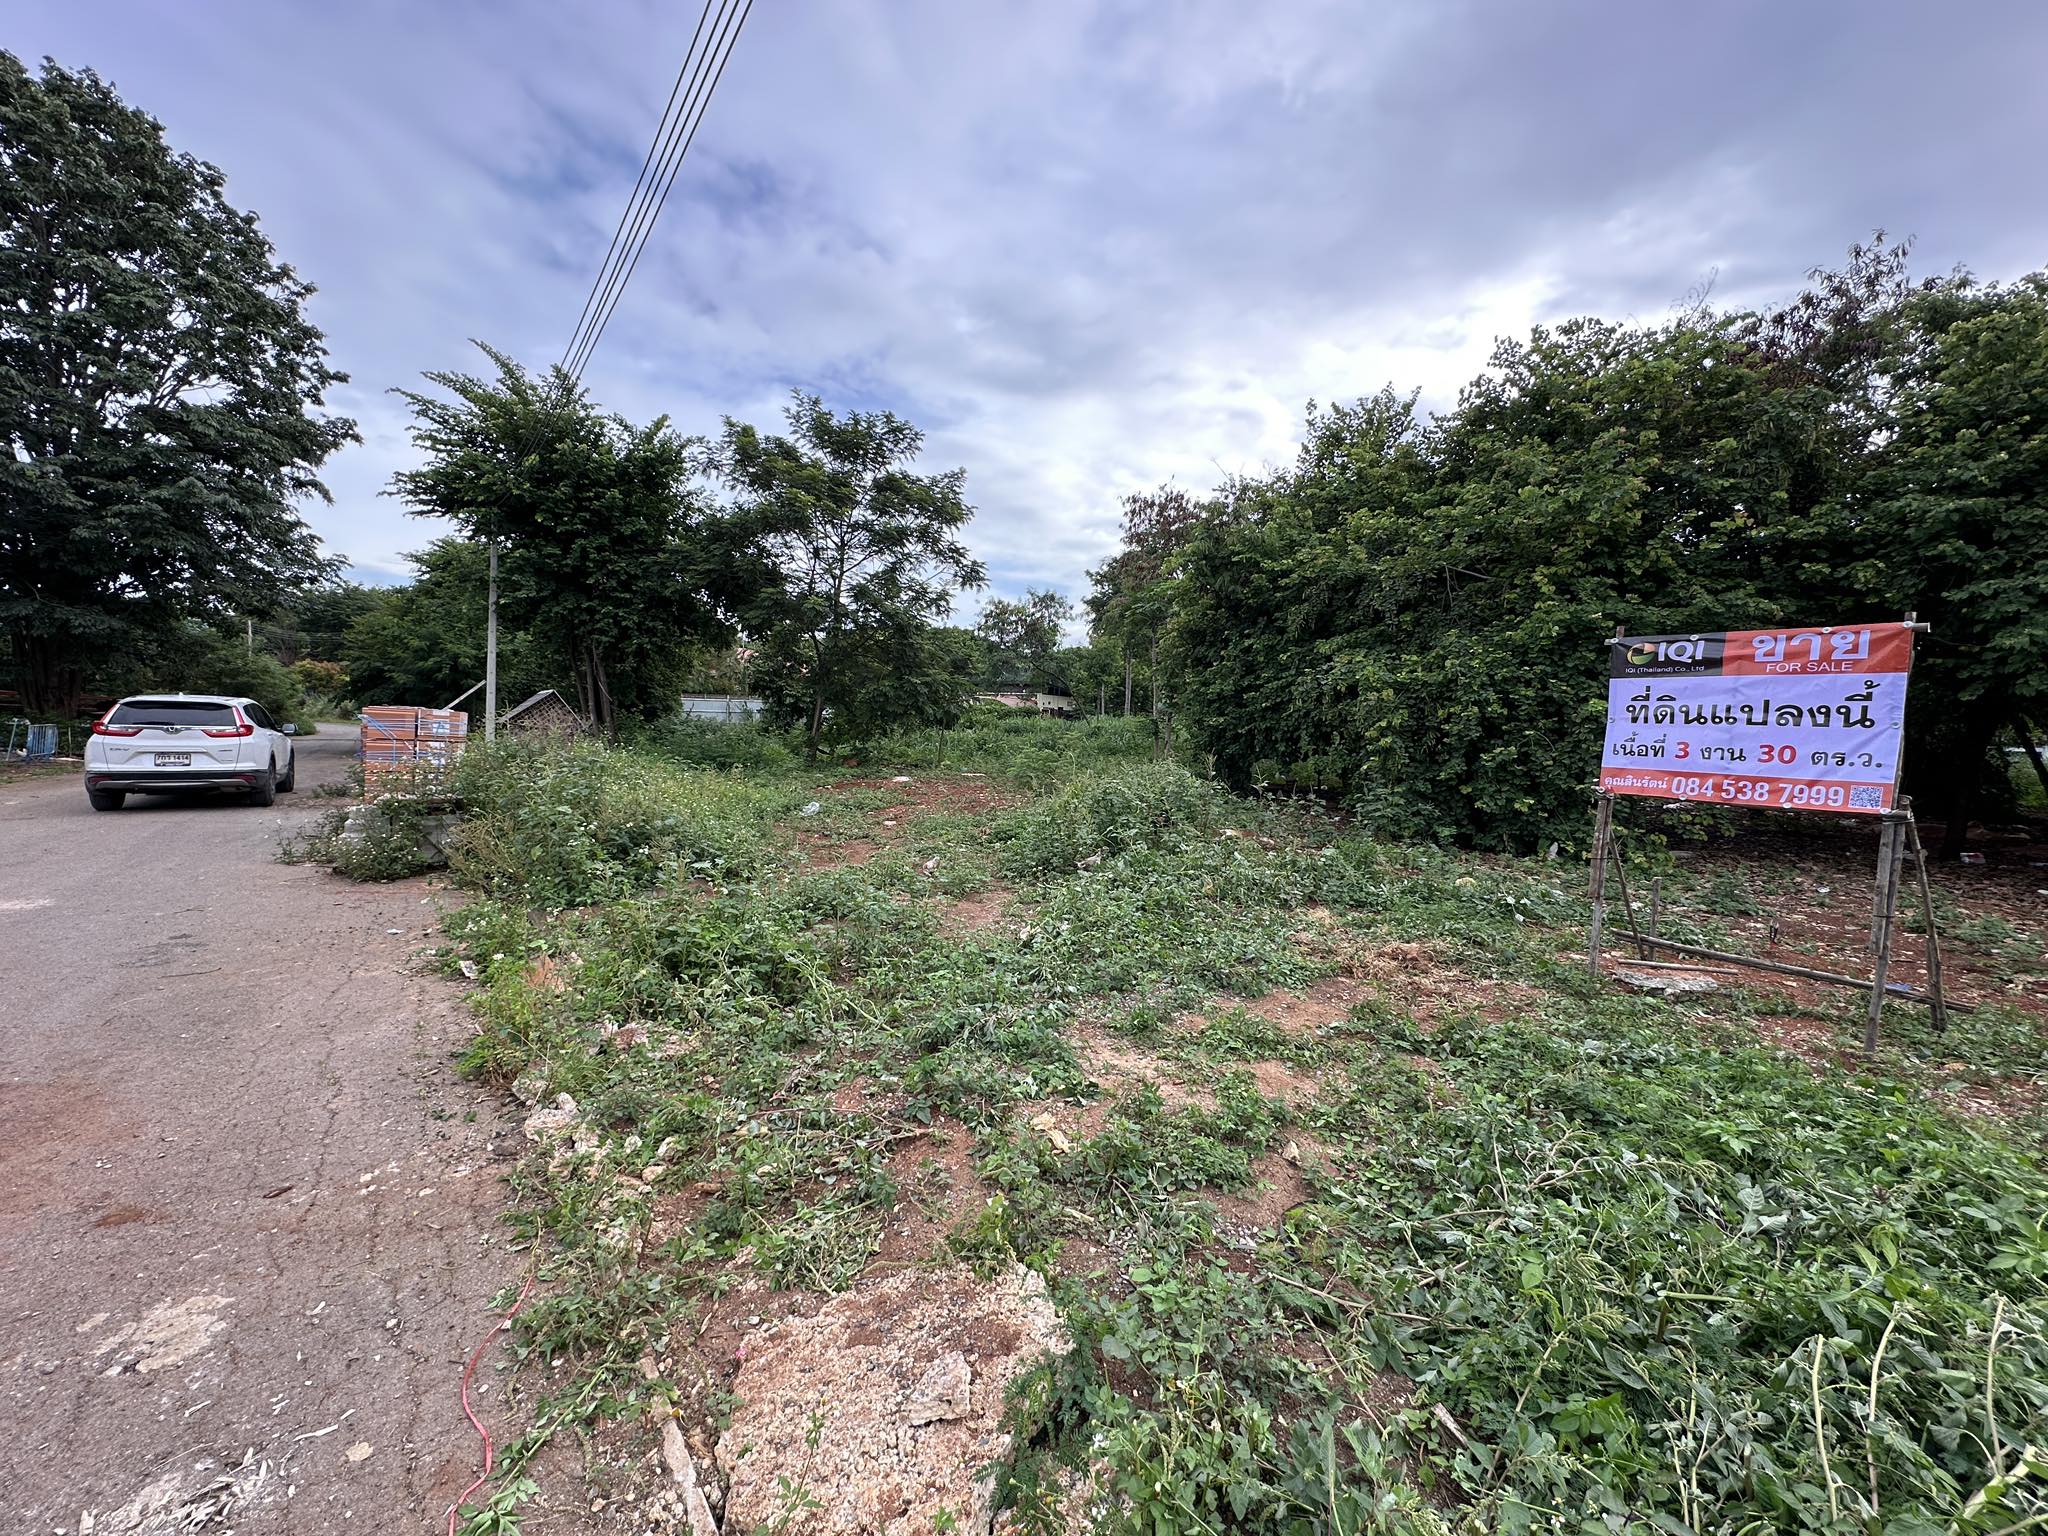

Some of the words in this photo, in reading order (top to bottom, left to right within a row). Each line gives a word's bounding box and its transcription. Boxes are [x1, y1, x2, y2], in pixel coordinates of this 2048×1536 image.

[1658, 641, 1705, 663] IQI
[1752, 630, 1871, 662] ขาย
[1637, 666, 1673, 674] (Thailand)
[1766, 662, 1801, 673] FOR
[1806, 661, 1853, 672] SALE
[1625, 680, 1881, 729] ที่ดินแปลงนี้
[1612, 731, 1667, 758] เนื้อที่
[1674, 741, 1690, 760] 3
[1700, 746, 1747, 762] งาน
[1757, 744, 1797, 765] 30
[1810, 750, 1883, 768] ตร.ว.
[1604, 775, 1669, 789] คุณสินรัตน์
[1671, 776, 1714, 798] 084
[1721, 779, 1770, 802] 538
[1778, 783, 1844, 806] 7999
